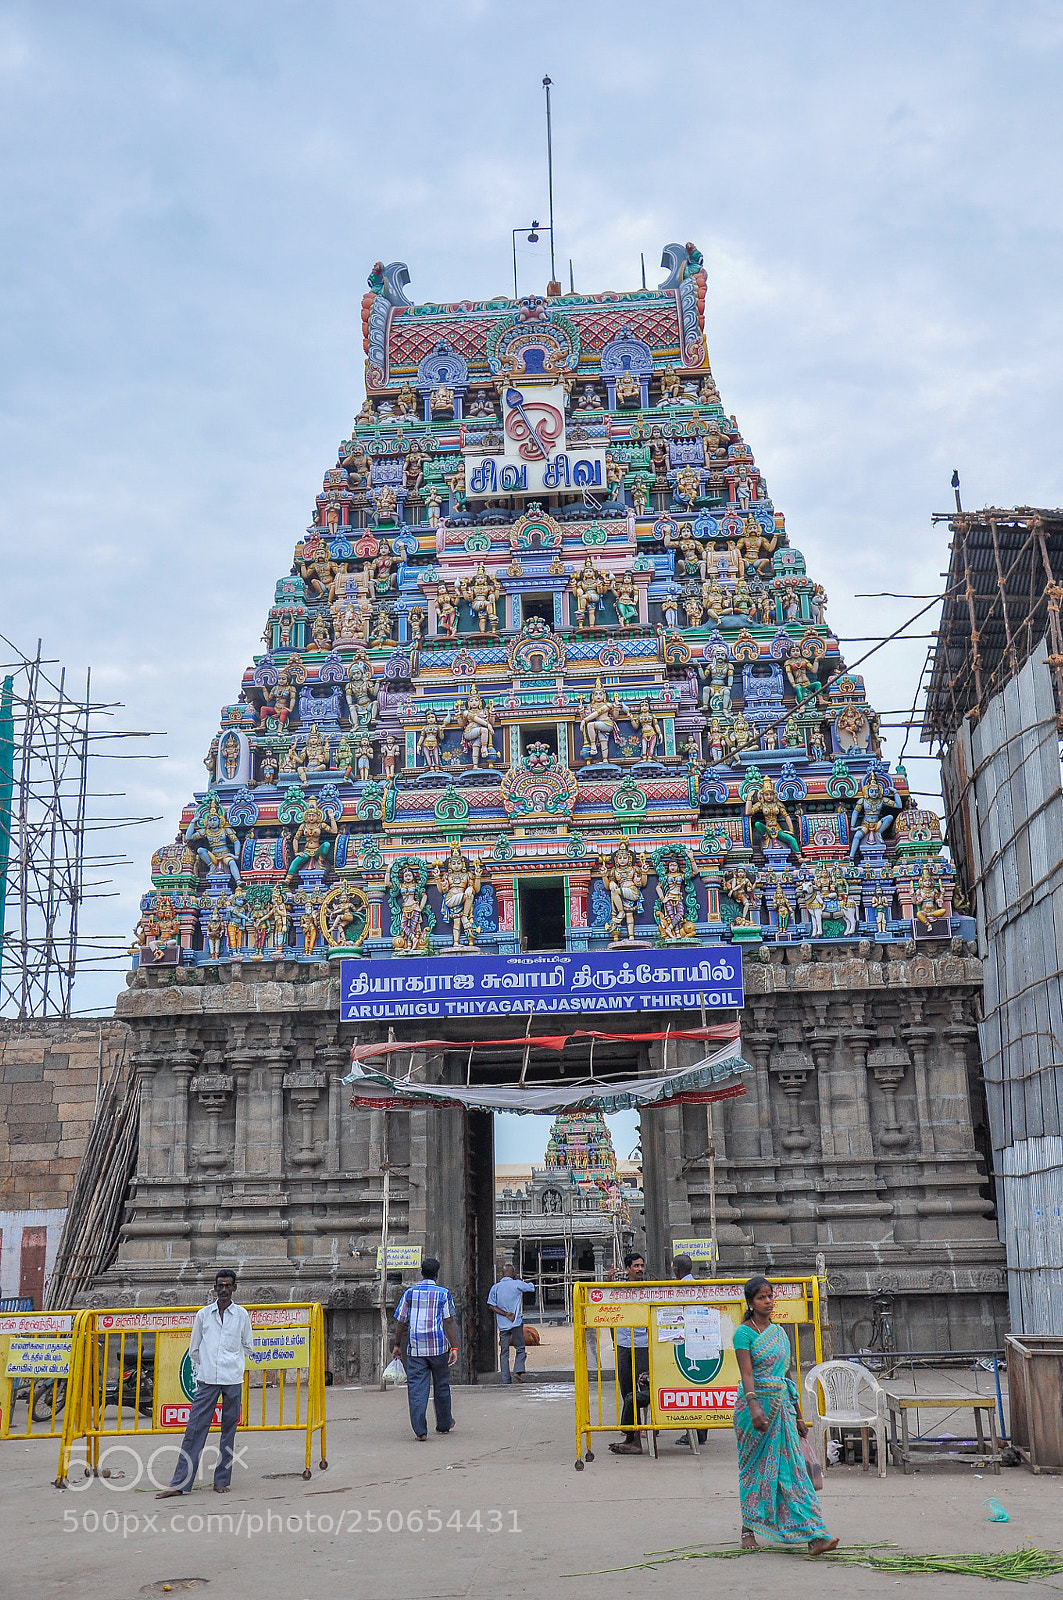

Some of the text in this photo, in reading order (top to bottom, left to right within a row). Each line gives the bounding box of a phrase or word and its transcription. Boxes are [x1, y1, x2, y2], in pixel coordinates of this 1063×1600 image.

[470, 453, 602, 493] சிவ சிவ
[506, 955, 572, 965] அருள்மிகு
[348, 958, 735, 998] தியாகராஜ சுவாமி திருக்கோயில்
[347, 992, 738, 1018] ARULMIGU THIYAGARAJASWAMY THIRUKOIL
[663, 1391, 738, 1407] POTHYS
